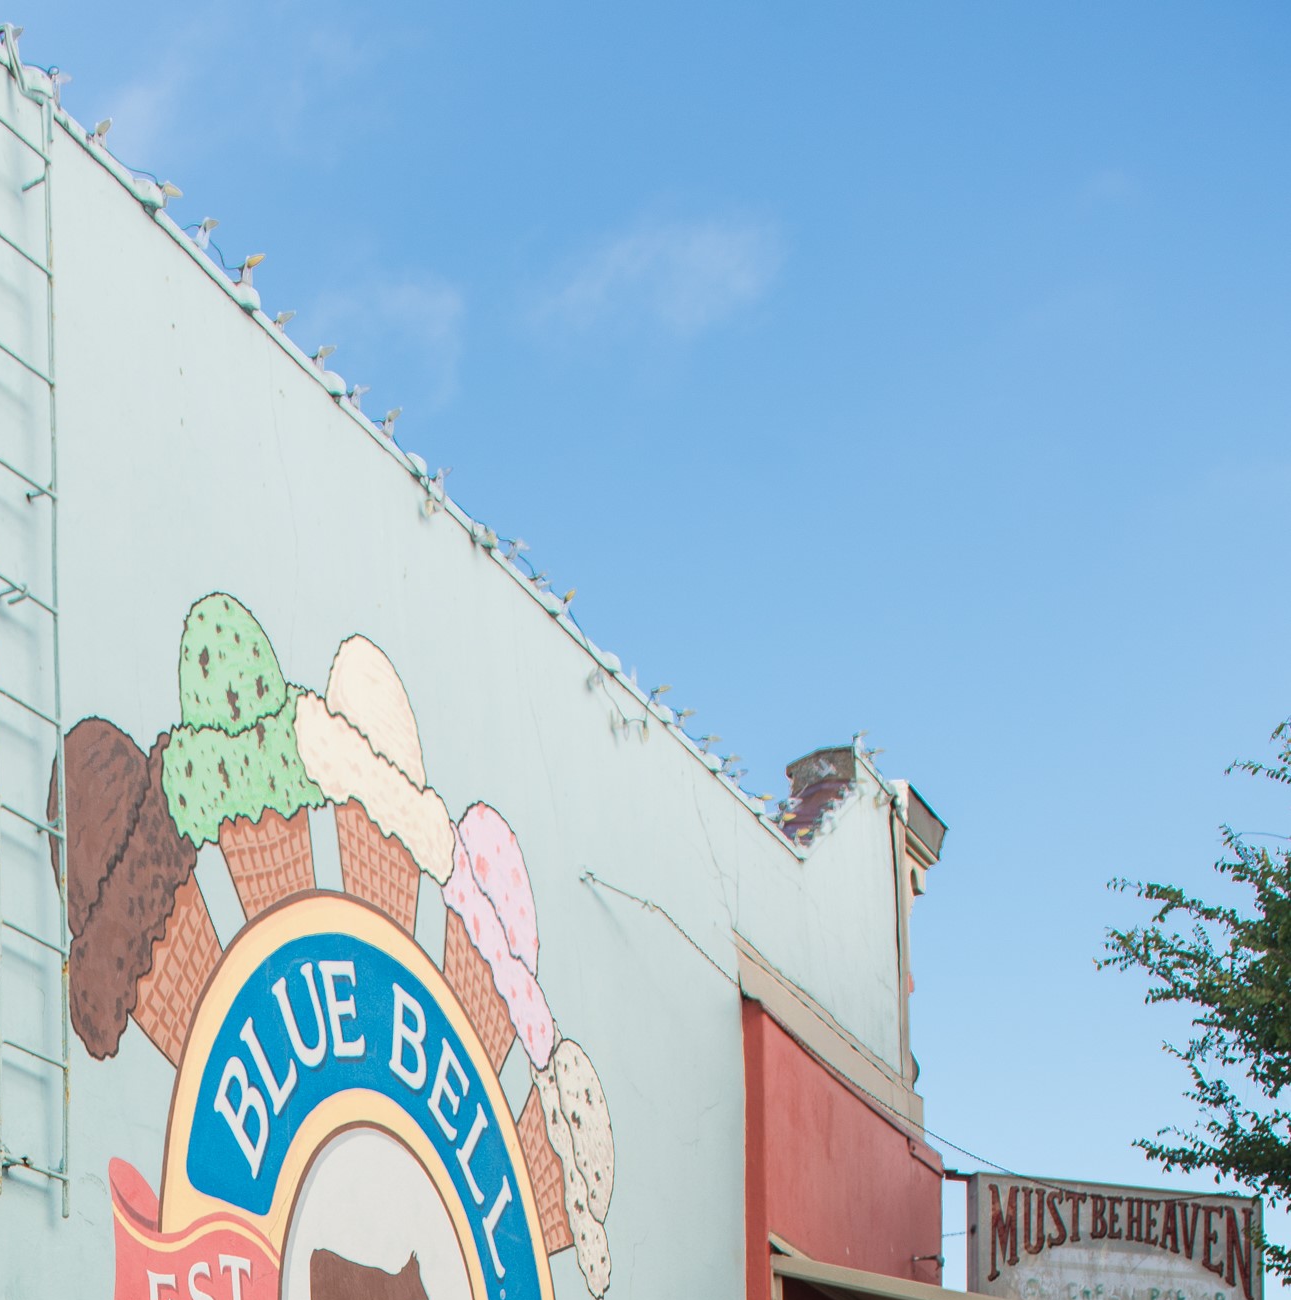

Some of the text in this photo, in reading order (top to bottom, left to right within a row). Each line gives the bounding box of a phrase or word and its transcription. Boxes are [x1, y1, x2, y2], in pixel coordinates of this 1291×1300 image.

[213, 959, 512, 1278] BLUE BELL
[988, 1184, 1255, 1300] MUST BE HEAVEN
